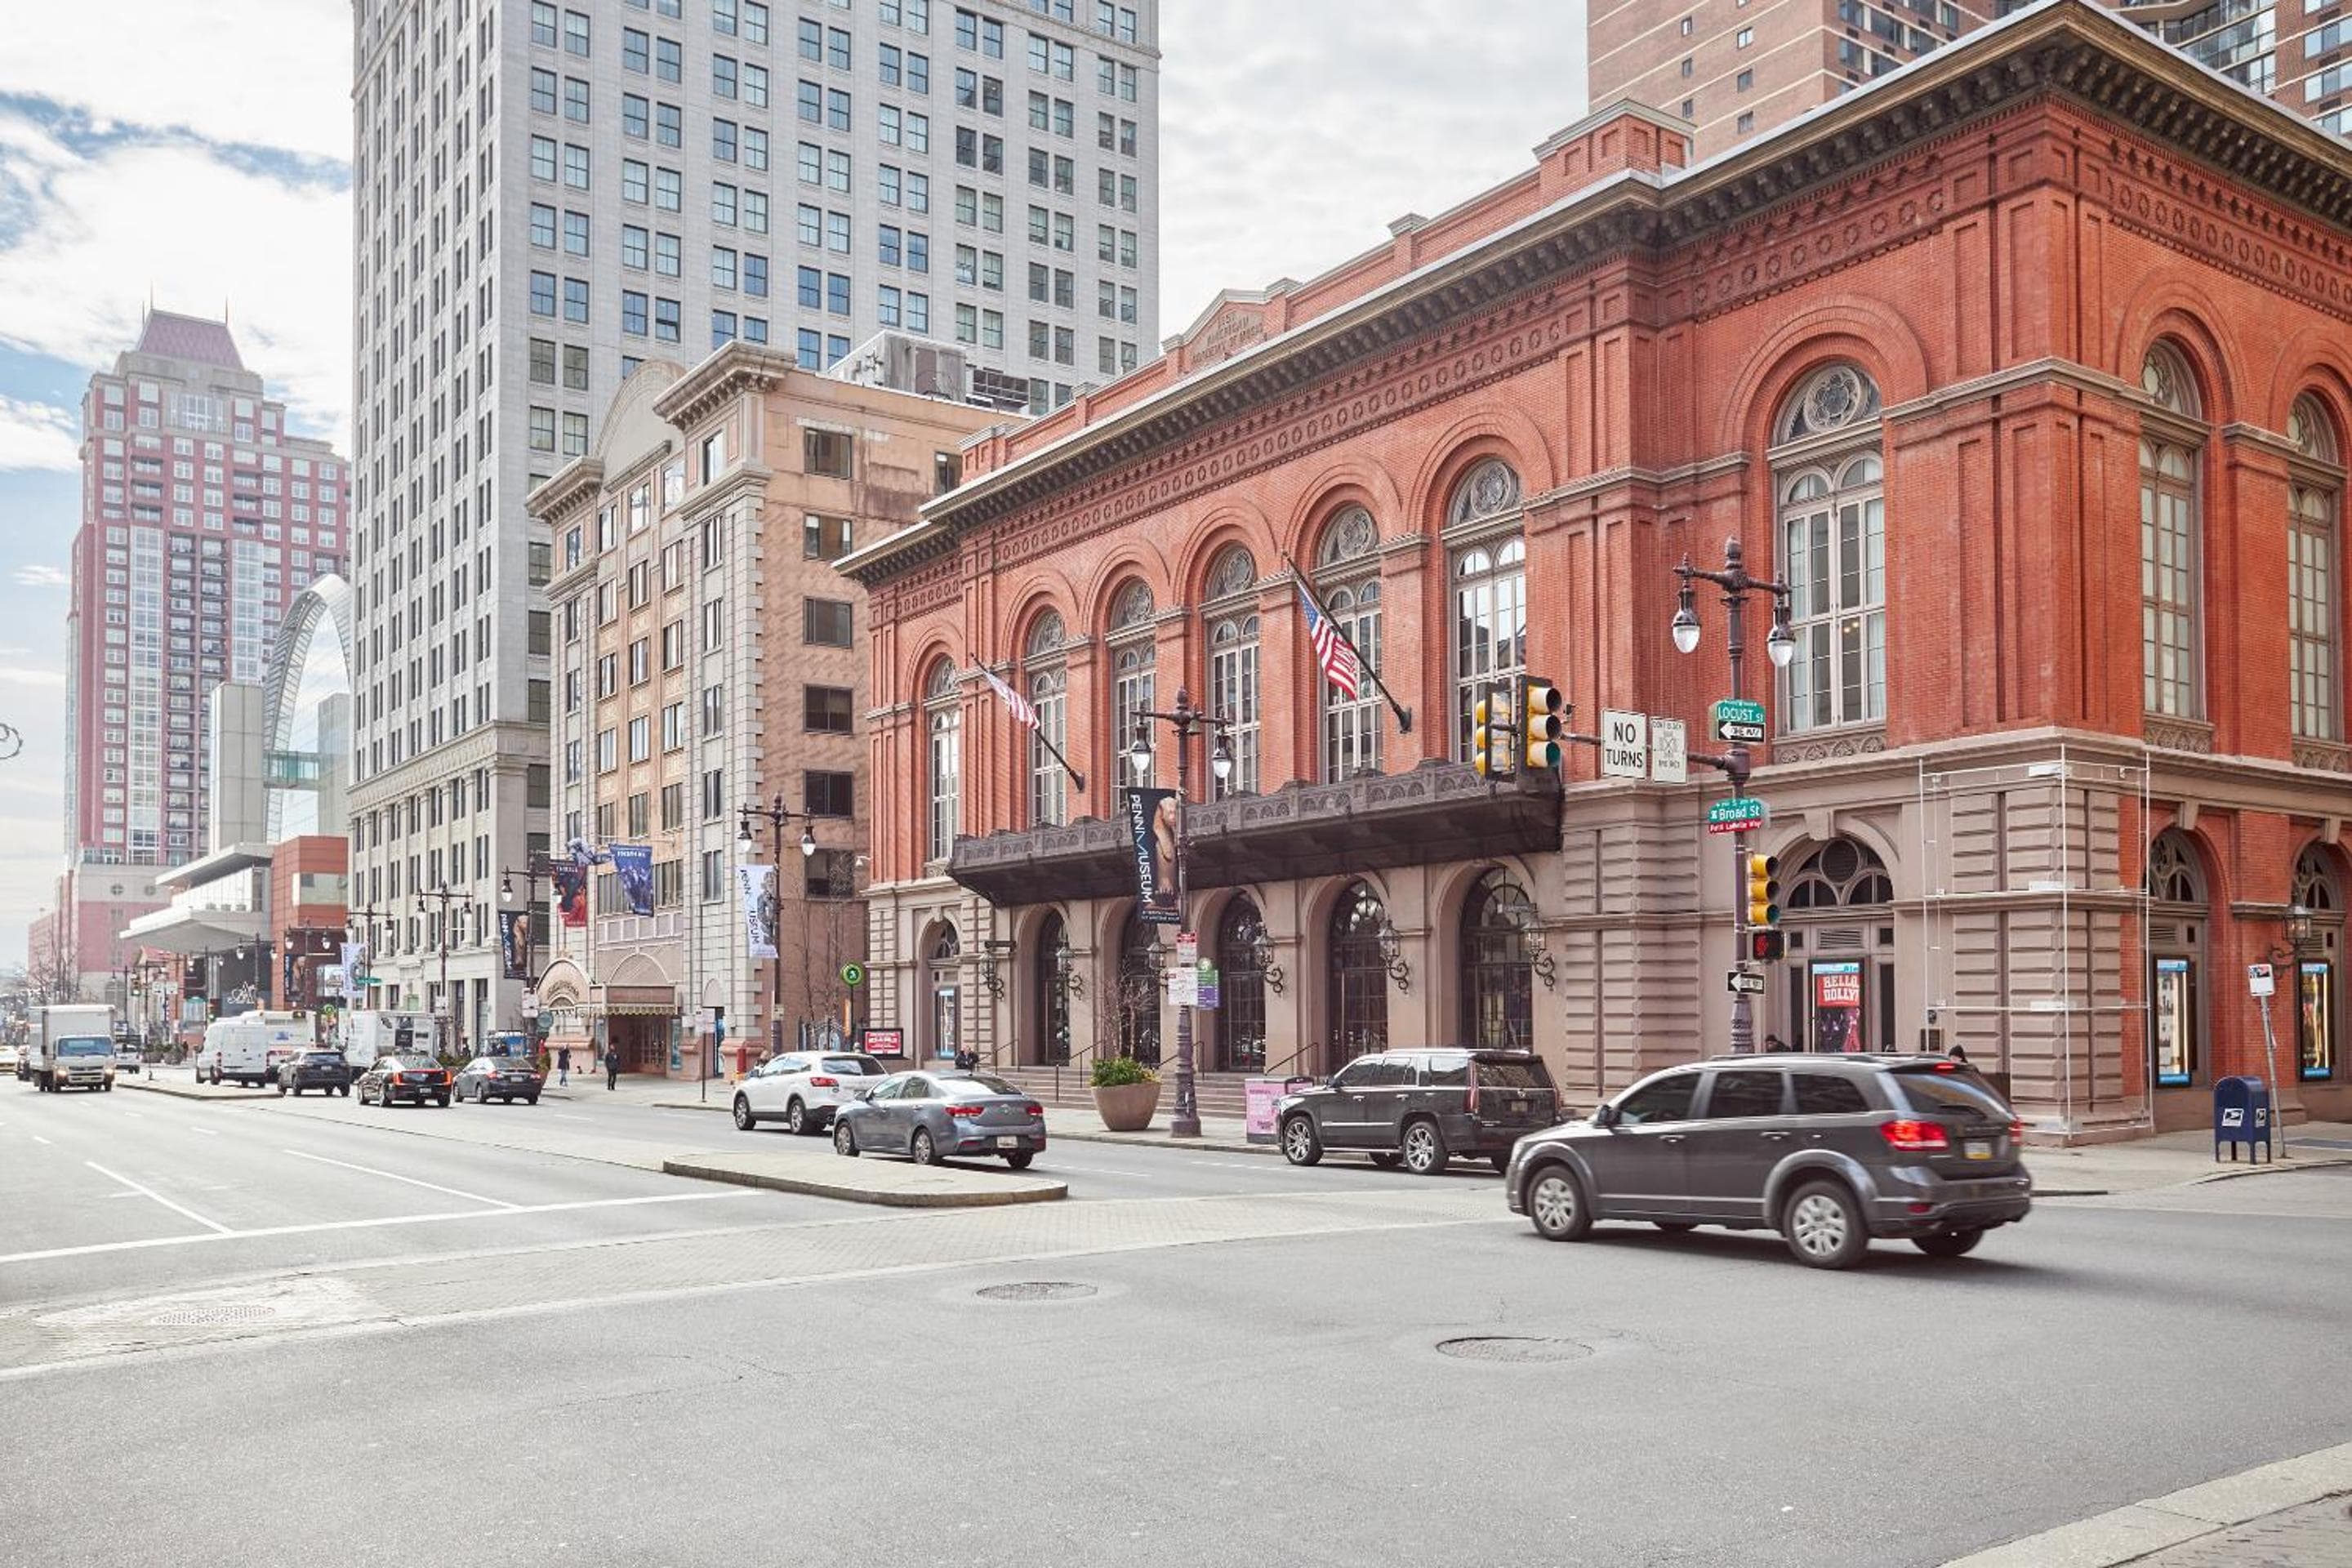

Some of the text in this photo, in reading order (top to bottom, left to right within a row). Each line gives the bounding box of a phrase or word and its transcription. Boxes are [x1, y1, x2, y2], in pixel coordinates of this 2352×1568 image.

[1717, 706, 1753, 721] LOCUST
[1613, 721, 1636, 743] NO
[1606, 749, 1643, 768] TURNS
[1718, 805, 1747, 821] Broad
[1749, 804, 1761, 817] St
[1130, 794, 1153, 903] PENN MUSEUM
[1823, 987, 1860, 1001] DOLLY!
